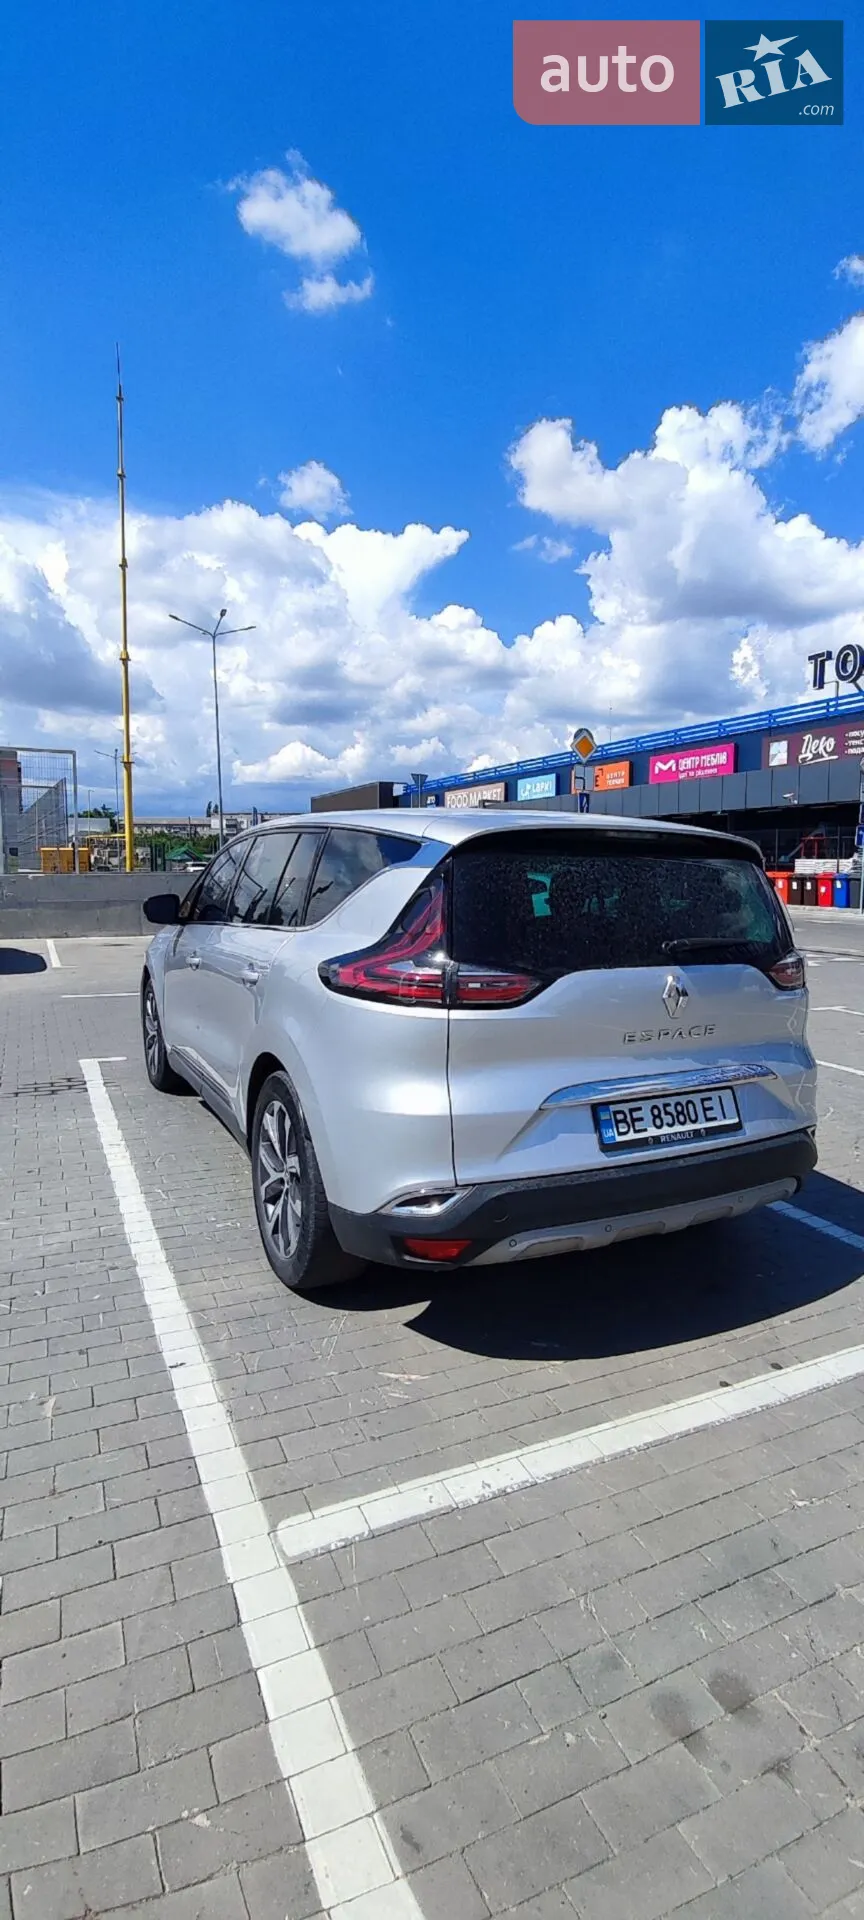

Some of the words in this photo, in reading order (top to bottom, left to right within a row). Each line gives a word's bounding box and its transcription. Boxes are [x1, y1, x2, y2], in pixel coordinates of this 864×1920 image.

[678, 756, 700, 772] ЦЕНТР
[446, 793, 469, 808] FOOD
[469, 788, 502, 807] MARKET
[623, 1024, 716, 1045] ESPACE
[612, 1106, 648, 1137] BE
[650, 1101, 699, 1130] 8580
[603, 1127, 615, 1138] UA
[660, 1131, 695, 1144] RENAULT
